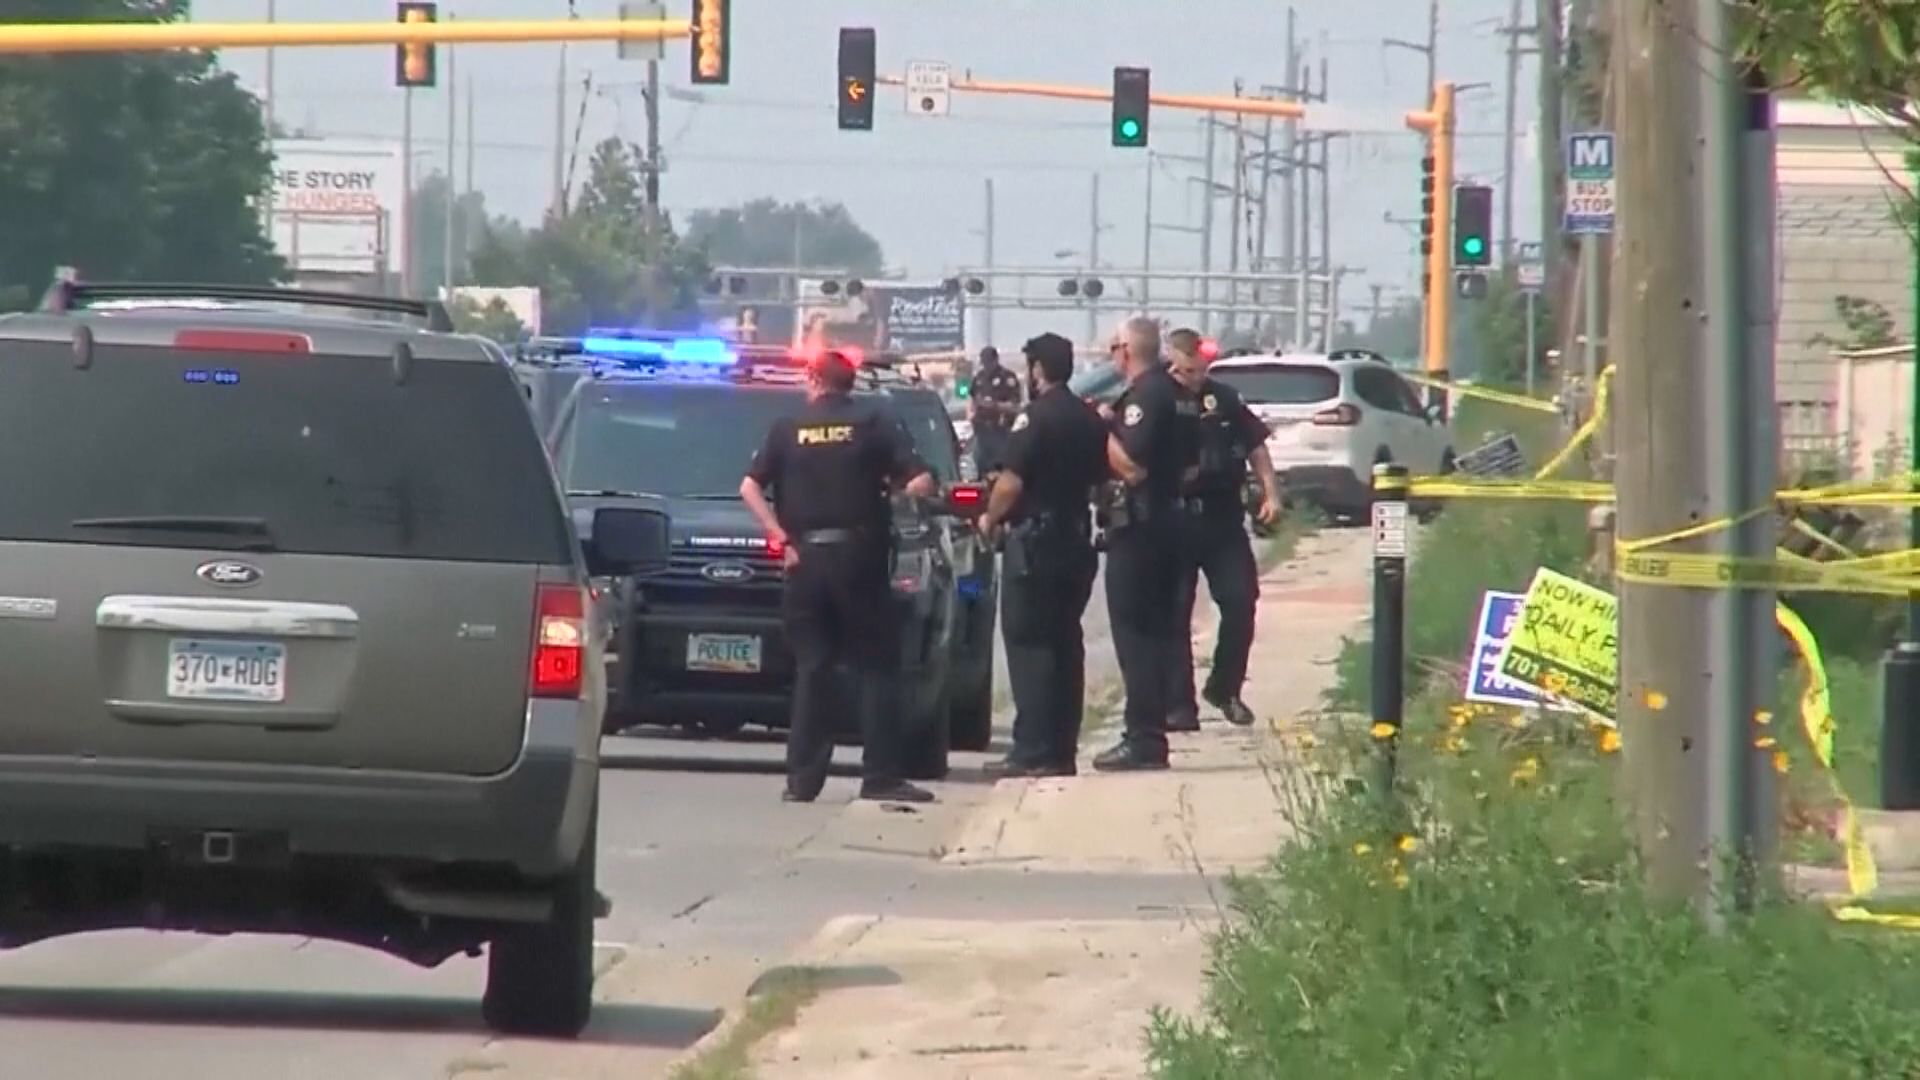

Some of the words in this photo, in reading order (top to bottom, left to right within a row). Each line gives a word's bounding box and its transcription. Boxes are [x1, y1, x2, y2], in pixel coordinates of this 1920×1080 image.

[1574, 138, 1609, 166] M
[272, 170, 299, 188] HE
[305, 170, 375, 188] STORY
[1576, 181, 1609, 196] BUS
[286, 192, 379, 210] HUNGER
[1571, 198, 1614, 213] STOP
[797, 424, 854, 445] POLICE
[1537, 580, 1591, 608] NOW
[1525, 604, 1599, 643] DAILY
[697, 642, 753, 661] POLICE
[175, 654, 218, 683] 370
[235, 655, 277, 685] RDG
